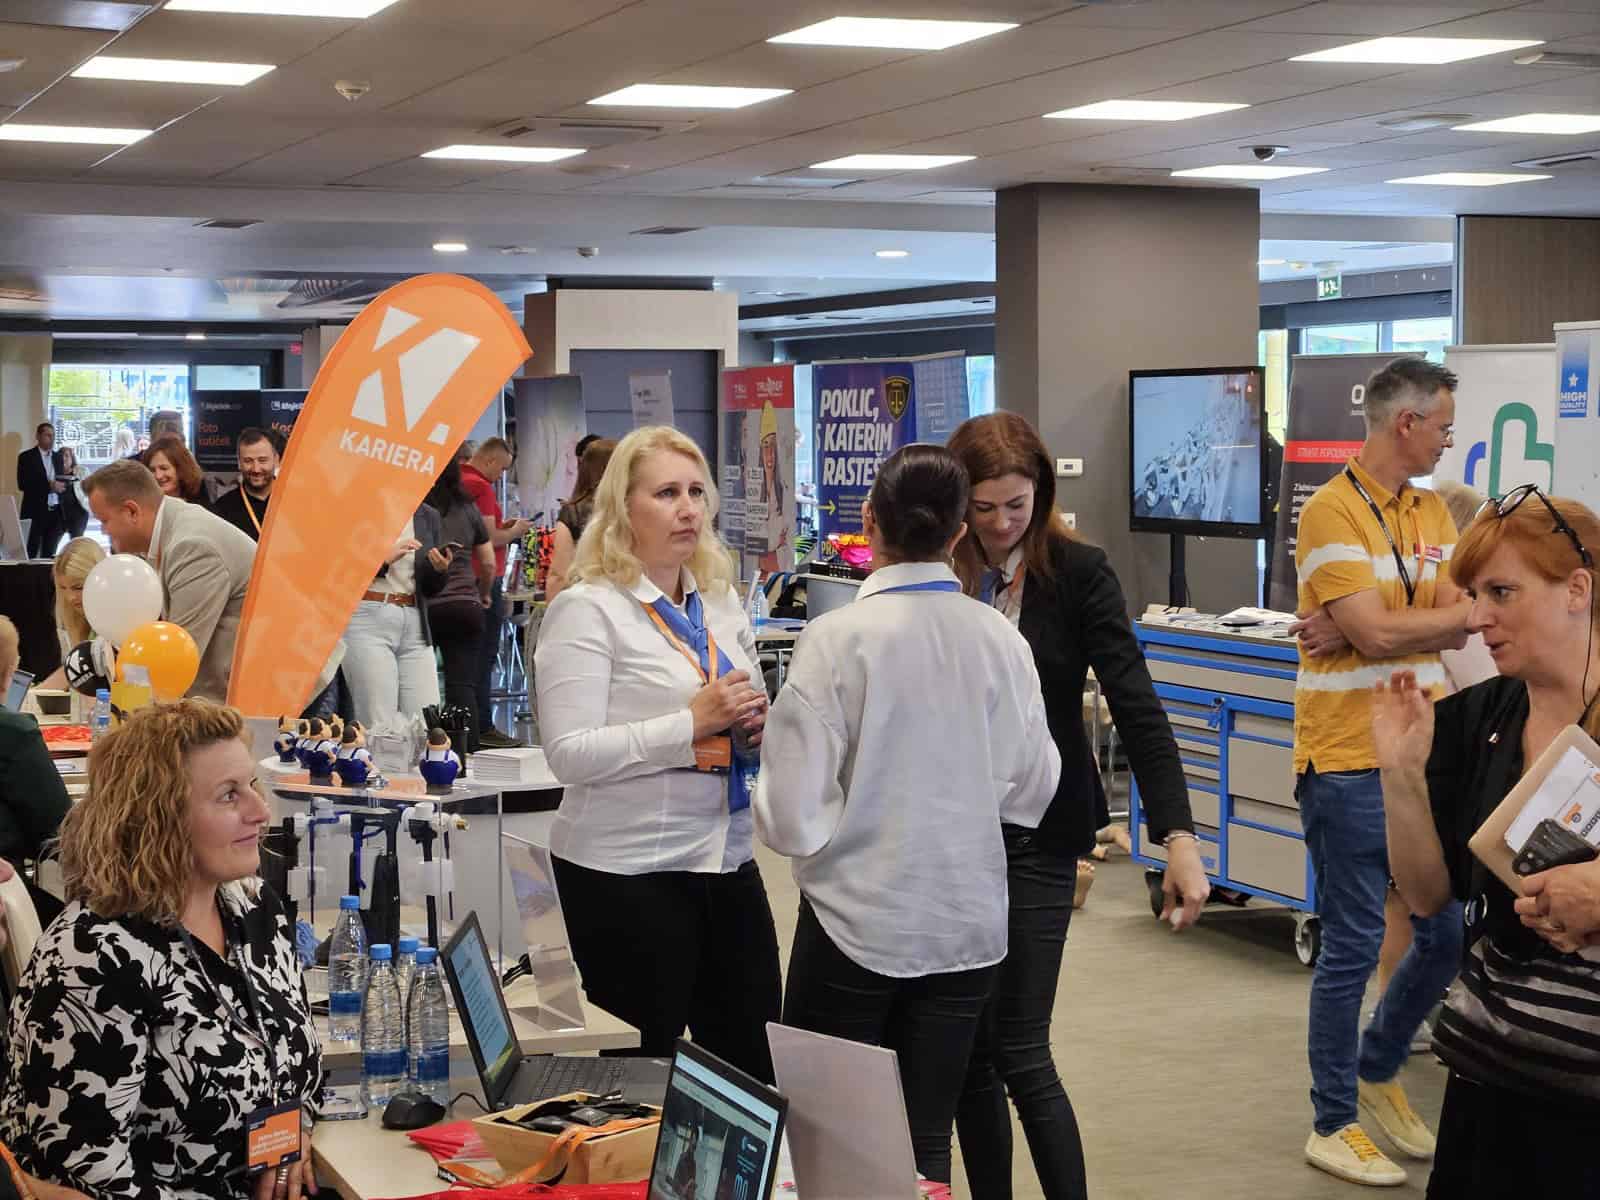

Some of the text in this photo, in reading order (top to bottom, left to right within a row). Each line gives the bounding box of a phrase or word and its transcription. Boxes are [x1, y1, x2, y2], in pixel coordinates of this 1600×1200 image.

[820, 387, 880, 422] POKLIC,
[1560, 391, 1587, 402] HIGH
[339, 428, 436, 475] KARIERA
[824, 422, 894, 452] KATERIM
